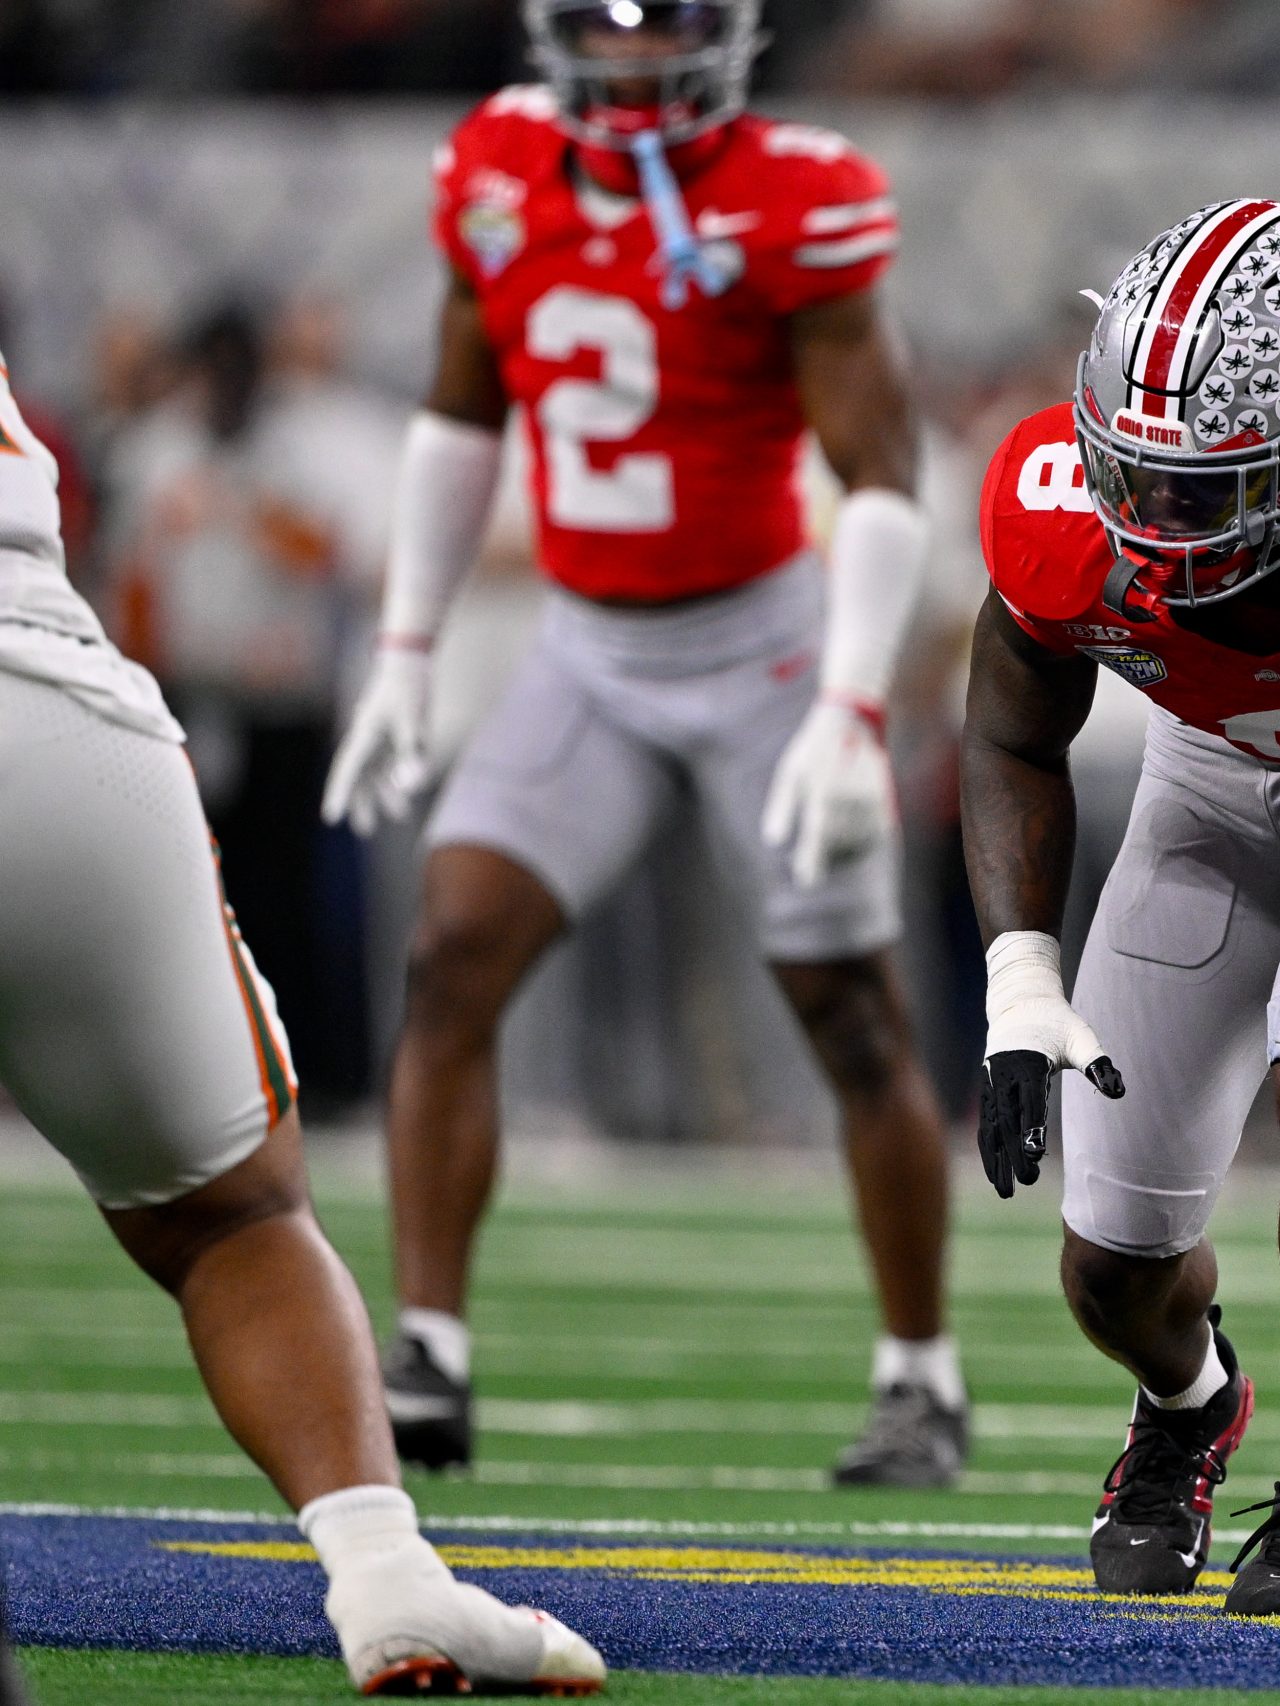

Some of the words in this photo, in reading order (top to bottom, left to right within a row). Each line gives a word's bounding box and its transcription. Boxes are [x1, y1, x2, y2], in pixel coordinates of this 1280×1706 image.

[526, 284, 676, 534] 2
[1116, 414, 1143, 439] OHIO
[1145, 425, 1183, 448] STATE
[1016, 440, 1096, 512] 8
